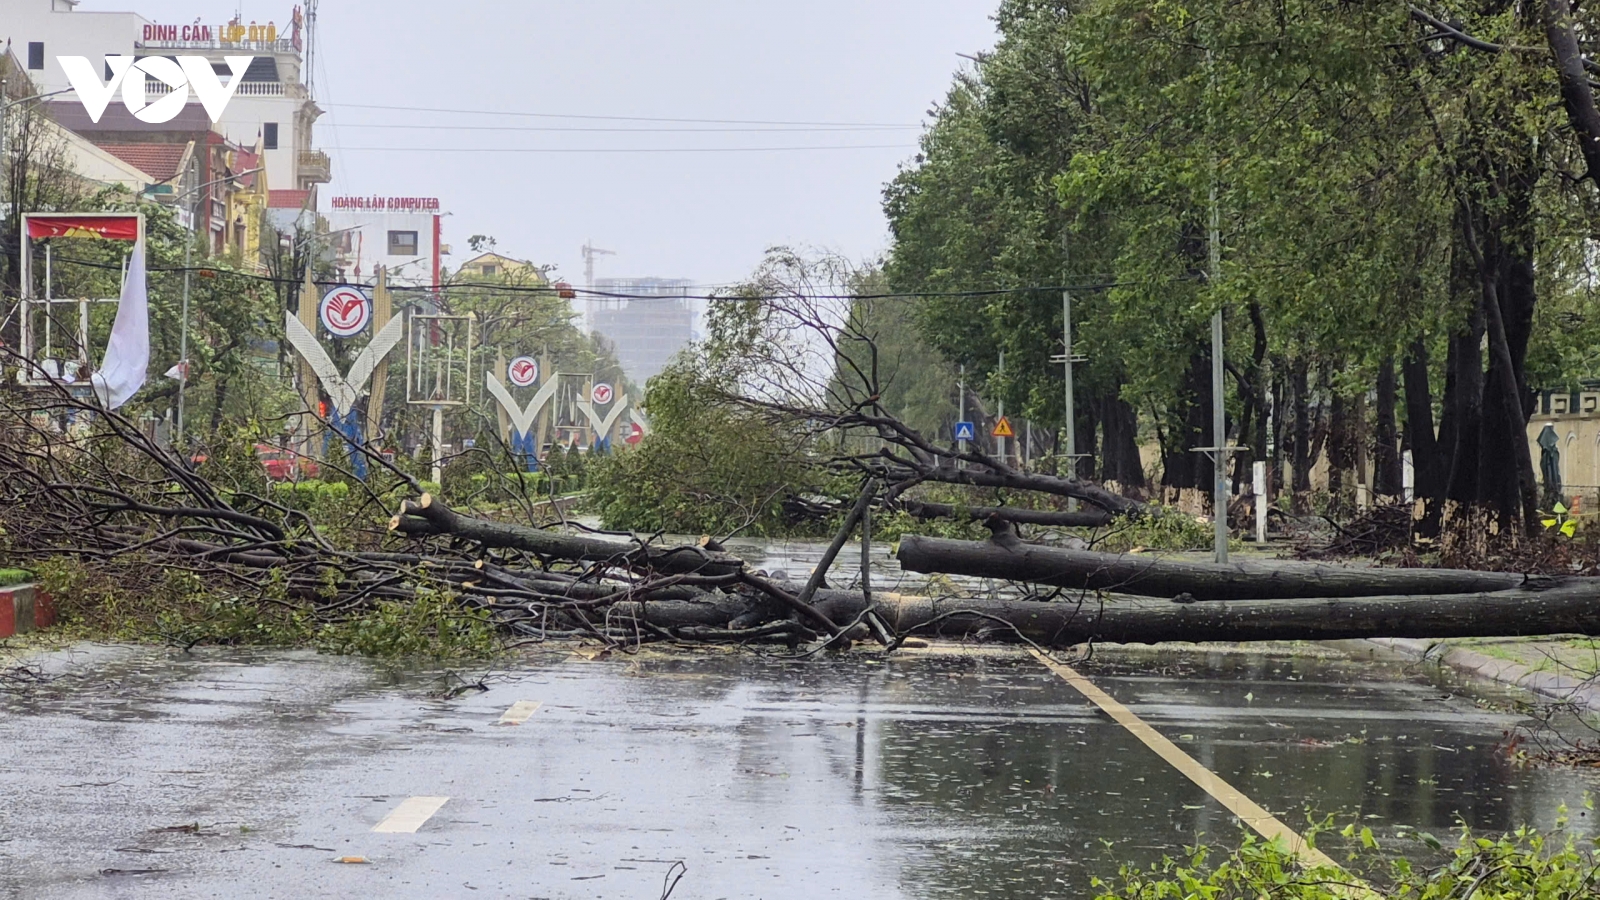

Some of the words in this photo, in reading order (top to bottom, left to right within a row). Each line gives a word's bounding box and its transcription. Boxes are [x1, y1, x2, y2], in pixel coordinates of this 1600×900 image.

[143, 19, 177, 41] ĐÌNH
[331, 193, 364, 209] HOÀNG
[387, 197, 440, 210] COMPUTER
